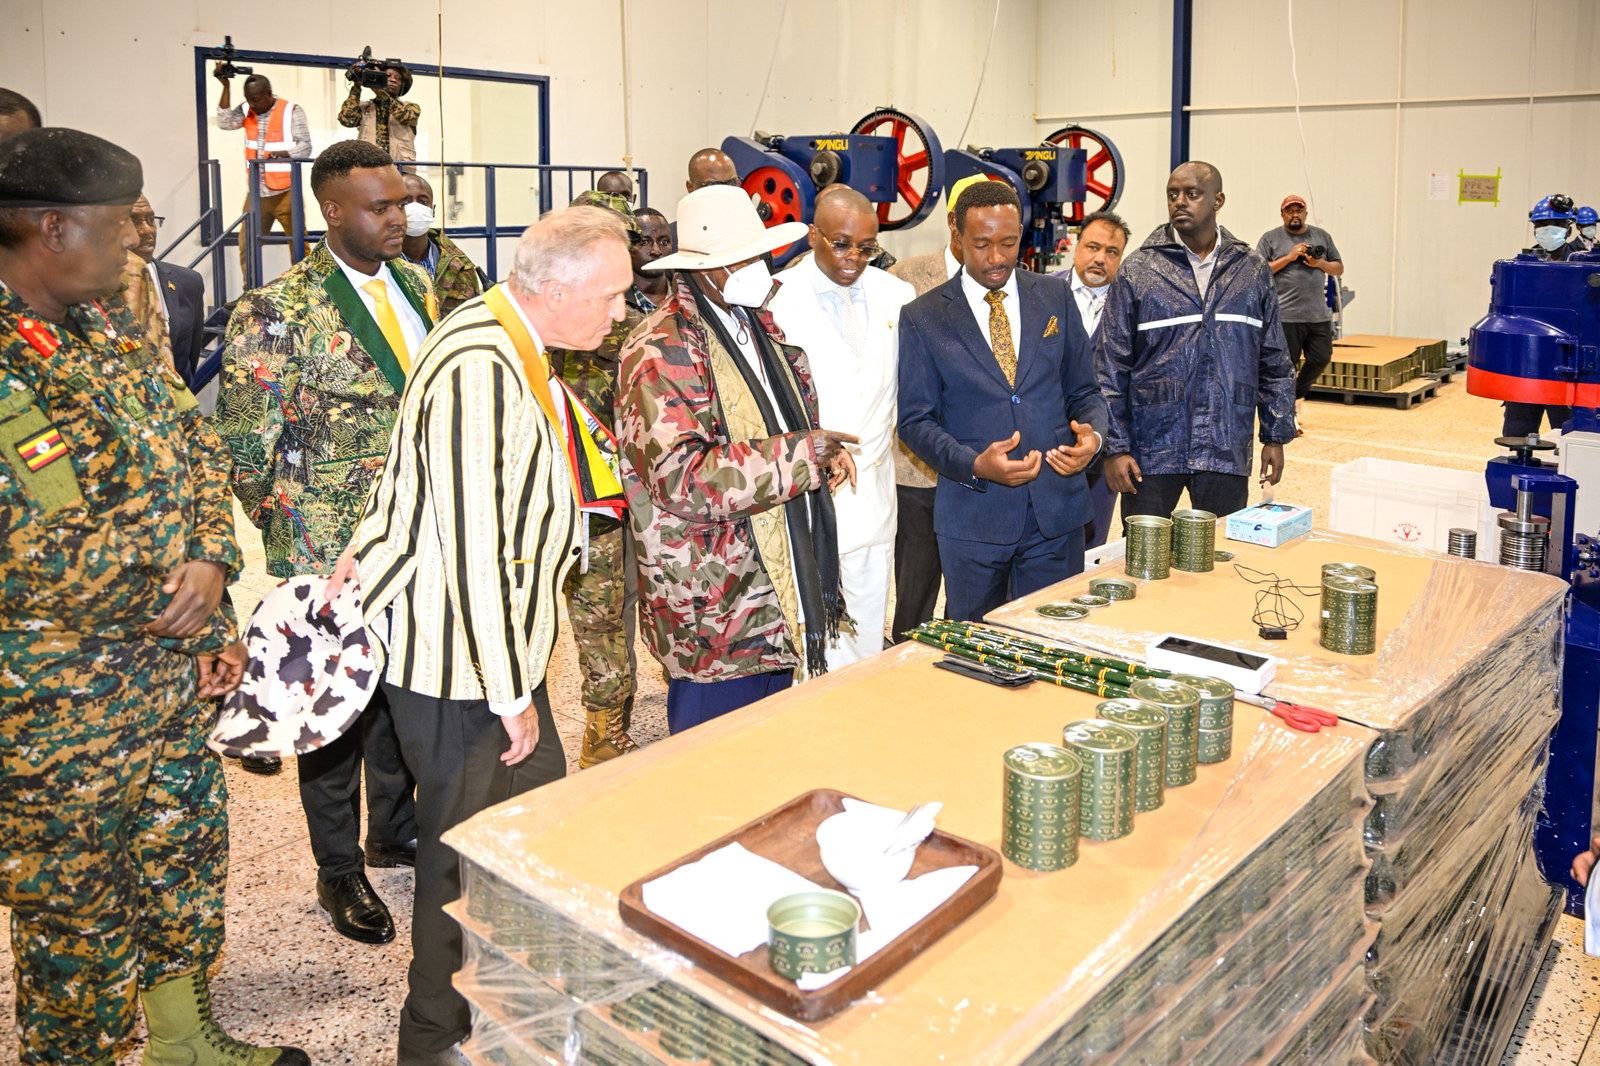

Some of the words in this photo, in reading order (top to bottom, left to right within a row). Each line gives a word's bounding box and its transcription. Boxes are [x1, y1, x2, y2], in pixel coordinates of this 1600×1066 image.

[816, 139, 849, 151] YANGLI
[1025, 150, 1056, 160] YANGLI
[1464, 181, 1482, 189] PPE
